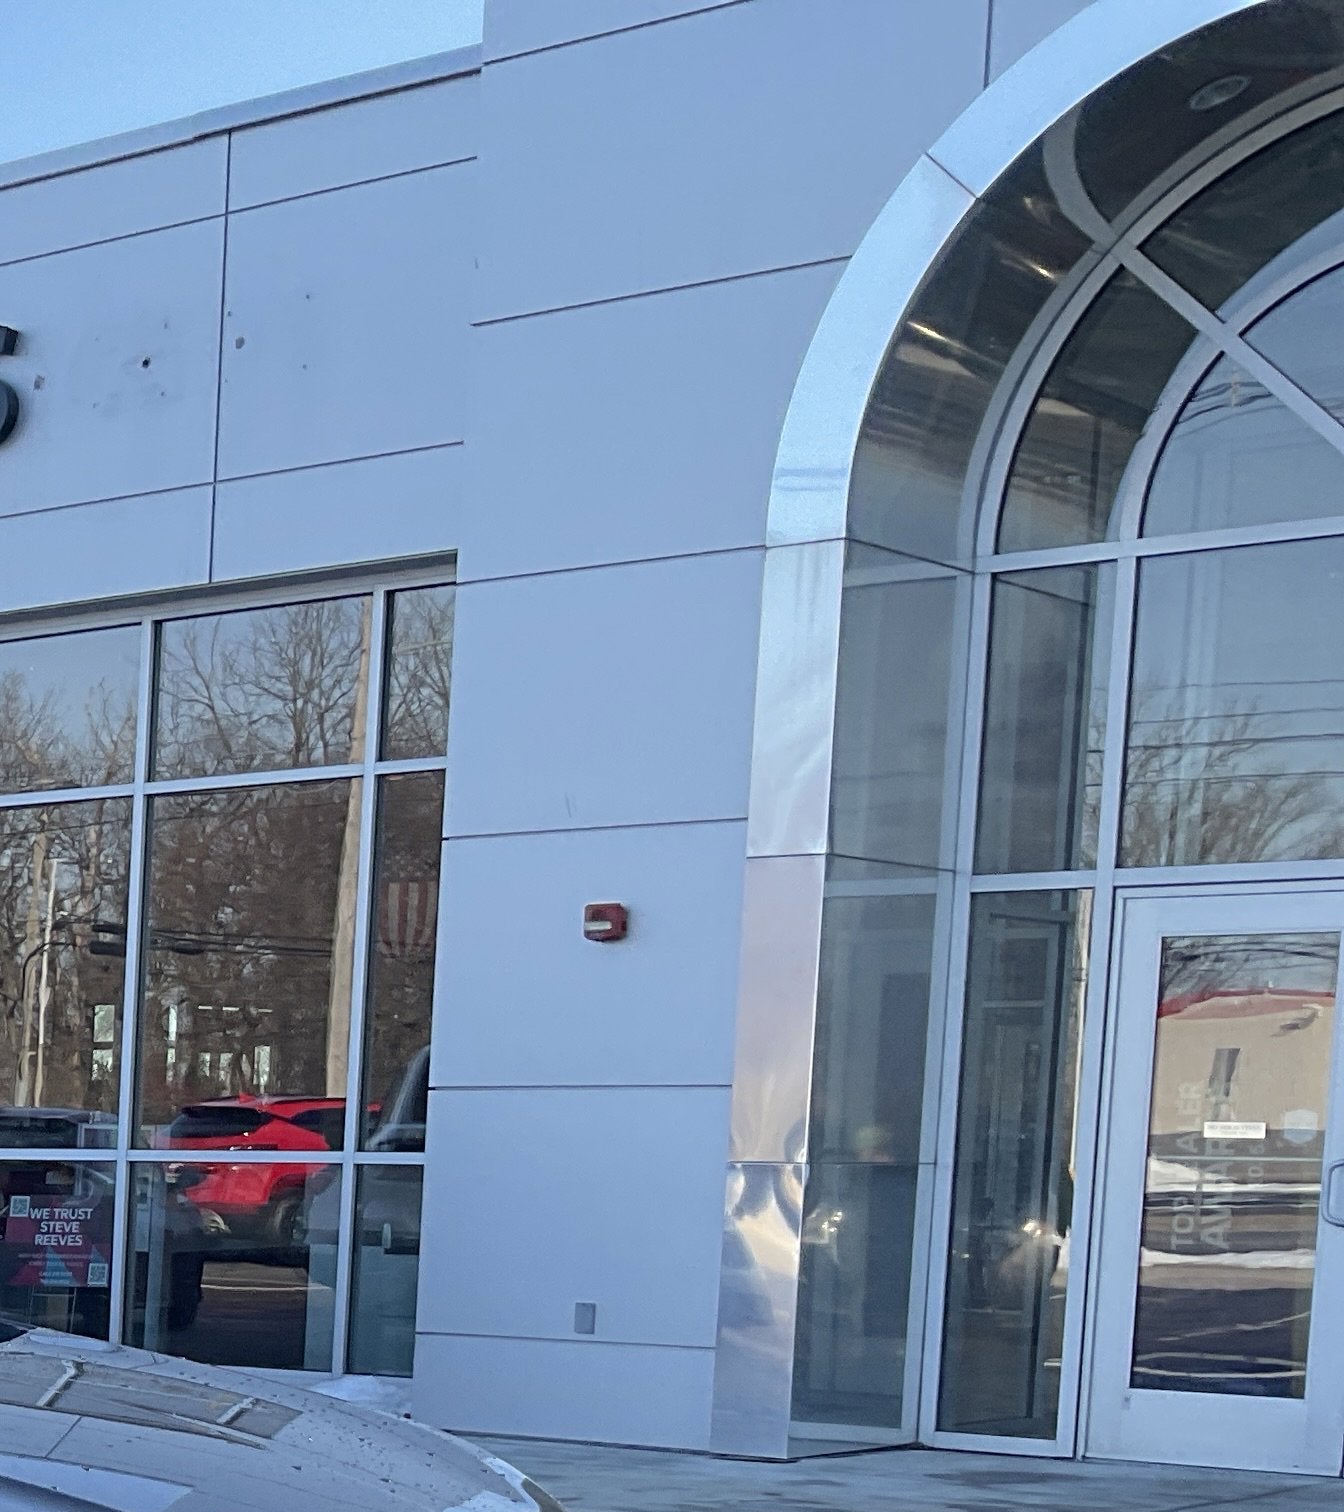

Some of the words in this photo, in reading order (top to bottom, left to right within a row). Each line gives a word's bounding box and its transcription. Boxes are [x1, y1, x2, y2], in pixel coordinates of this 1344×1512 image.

[29, 1208, 51, 1220] WE
[54, 1208, 93, 1220] TRUST
[40, 1221, 80, 1233] STEVE
[34, 1234, 83, 1246] REEVES
